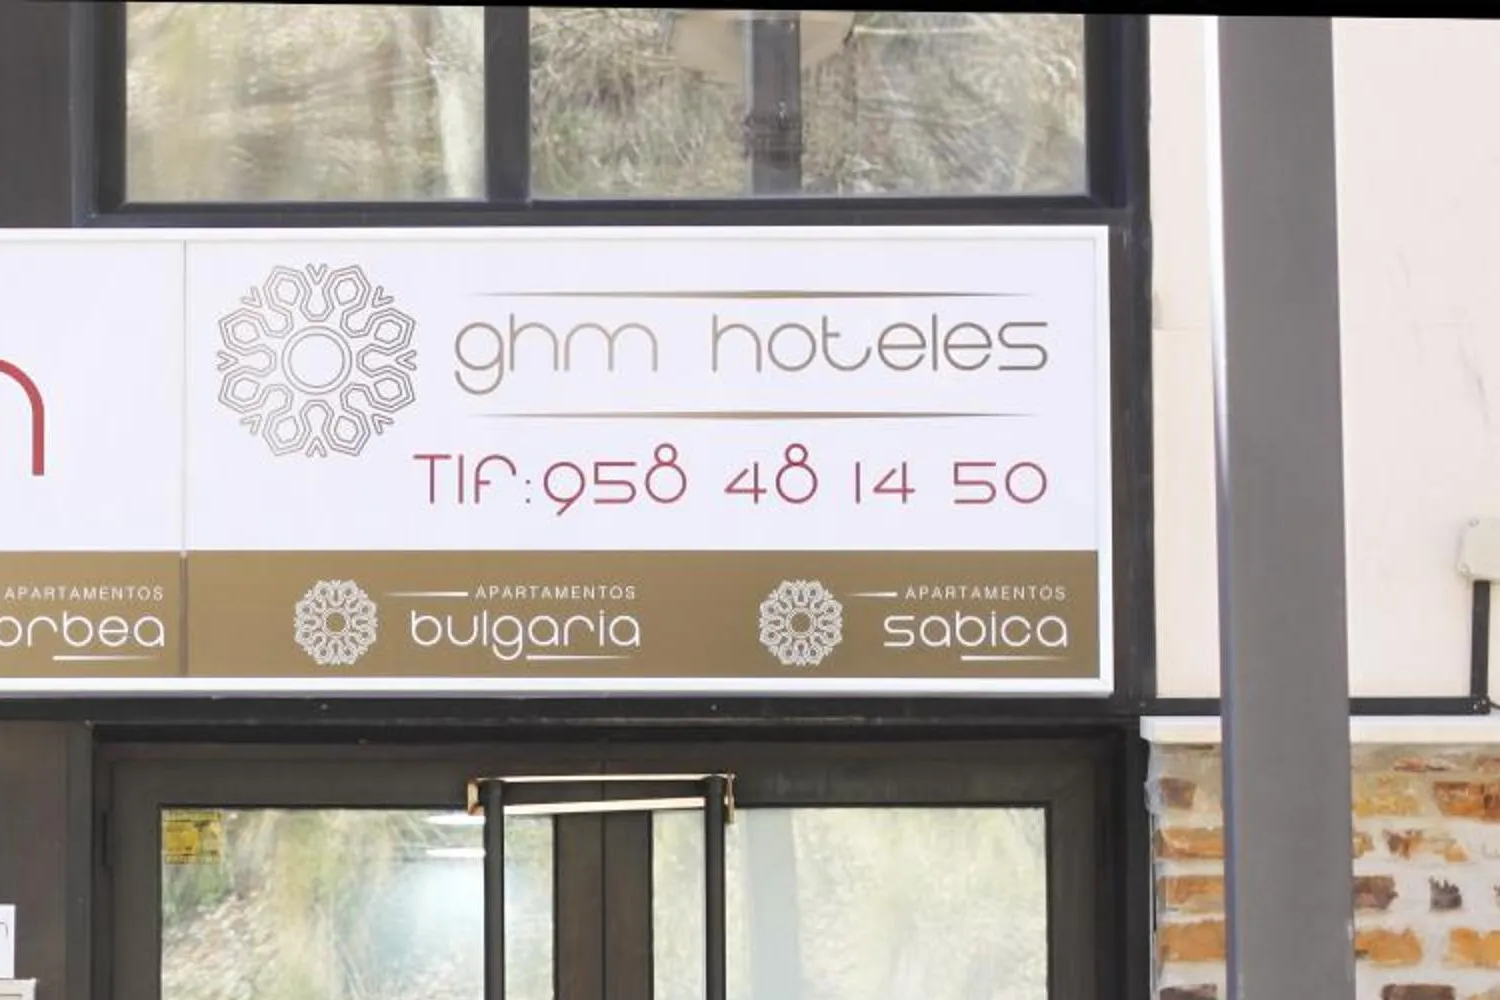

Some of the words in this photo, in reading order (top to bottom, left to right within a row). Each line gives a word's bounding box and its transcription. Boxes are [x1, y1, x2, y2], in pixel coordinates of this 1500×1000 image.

[455, 313, 658, 395] ghm
[711, 313, 1049, 373] hoteles
[724, 443, 818, 504] 48
[855, 461, 916, 504] 14
[953, 461, 1048, 504] 50
[4, 585, 165, 601] APARTAMENTOS
[475, 584, 637, 600] APARTAMENTOS
[905, 585, 1067, 601] APARTAMENTOS
[411, 610, 641, 661] bulgaria
[883, 610, 1068, 649] sabica
